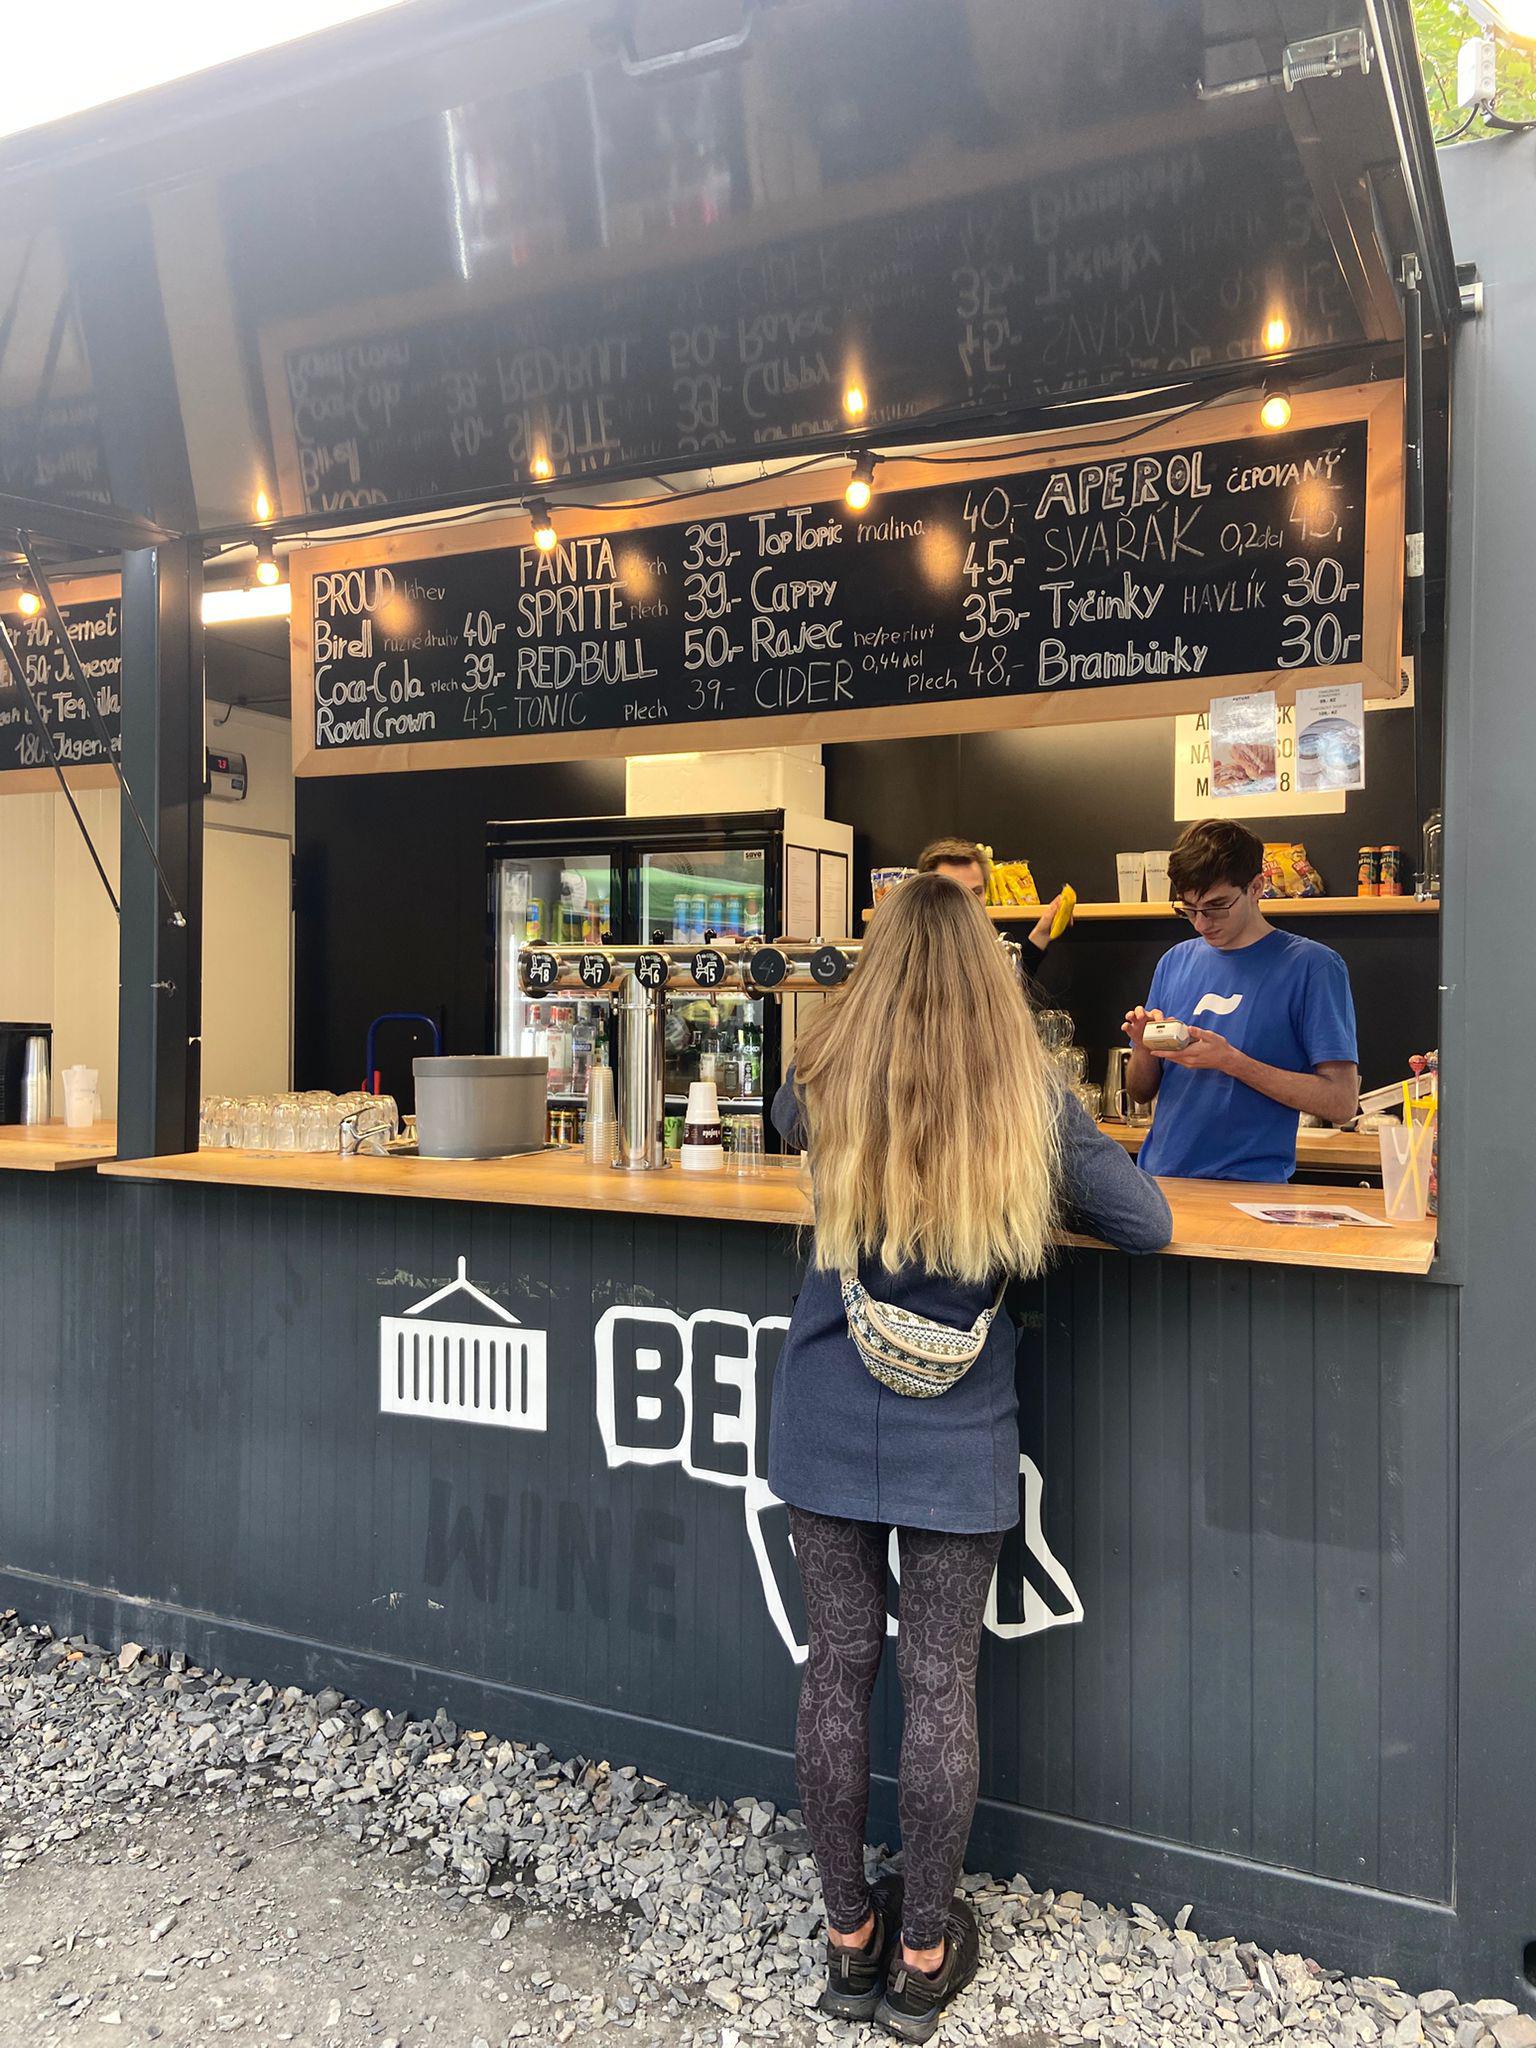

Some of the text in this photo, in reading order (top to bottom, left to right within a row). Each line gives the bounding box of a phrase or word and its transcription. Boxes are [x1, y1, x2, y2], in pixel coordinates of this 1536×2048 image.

[1035, 451, 1211, 519] APEROL
[857, 516, 925, 543] malina
[963, 487, 1028, 534] 40,-
[1044, 502, 1204, 572] SVAŘÁK
[519, 538, 618, 588] FANTA
[682, 522, 740, 570] 39,-
[750, 538, 1026, 613] Cappy 45,-
[314, 567, 395, 618] PROUD
[516, 581, 628, 638] SPRITE
[683, 571, 741, 622] 39,-
[1040, 557, 1360, 629] Tyčinky HAVLÍK 30,-
[314, 619, 373, 663] Birell
[463, 610, 505, 647] 40,-
[751, 617, 843, 662] Rajec
[959, 589, 1030, 643] 35,-
[1039, 613, 1360, 686] Brambůrky 30,-
[314, 659, 425, 707] Coca-Cola
[462, 653, 505, 692] 39,-
[516, 626, 743, 690] RED-BULL 50,-
[755, 659, 854, 709] CIDER
[968, 645, 1024, 687] 48,-
[52, 686, 121, 722] Teqilla
[316, 692, 507, 746] Royal Crown 45,-
[514, 691, 587, 729] TONIC
[687, 679, 736, 711] 39,-
[543, 968, 550, 982] 8
[596, 969, 602, 983] 7
[652, 969, 660, 983] 6
[709, 968, 716, 982] 5
[817, 955, 836, 977] 3
